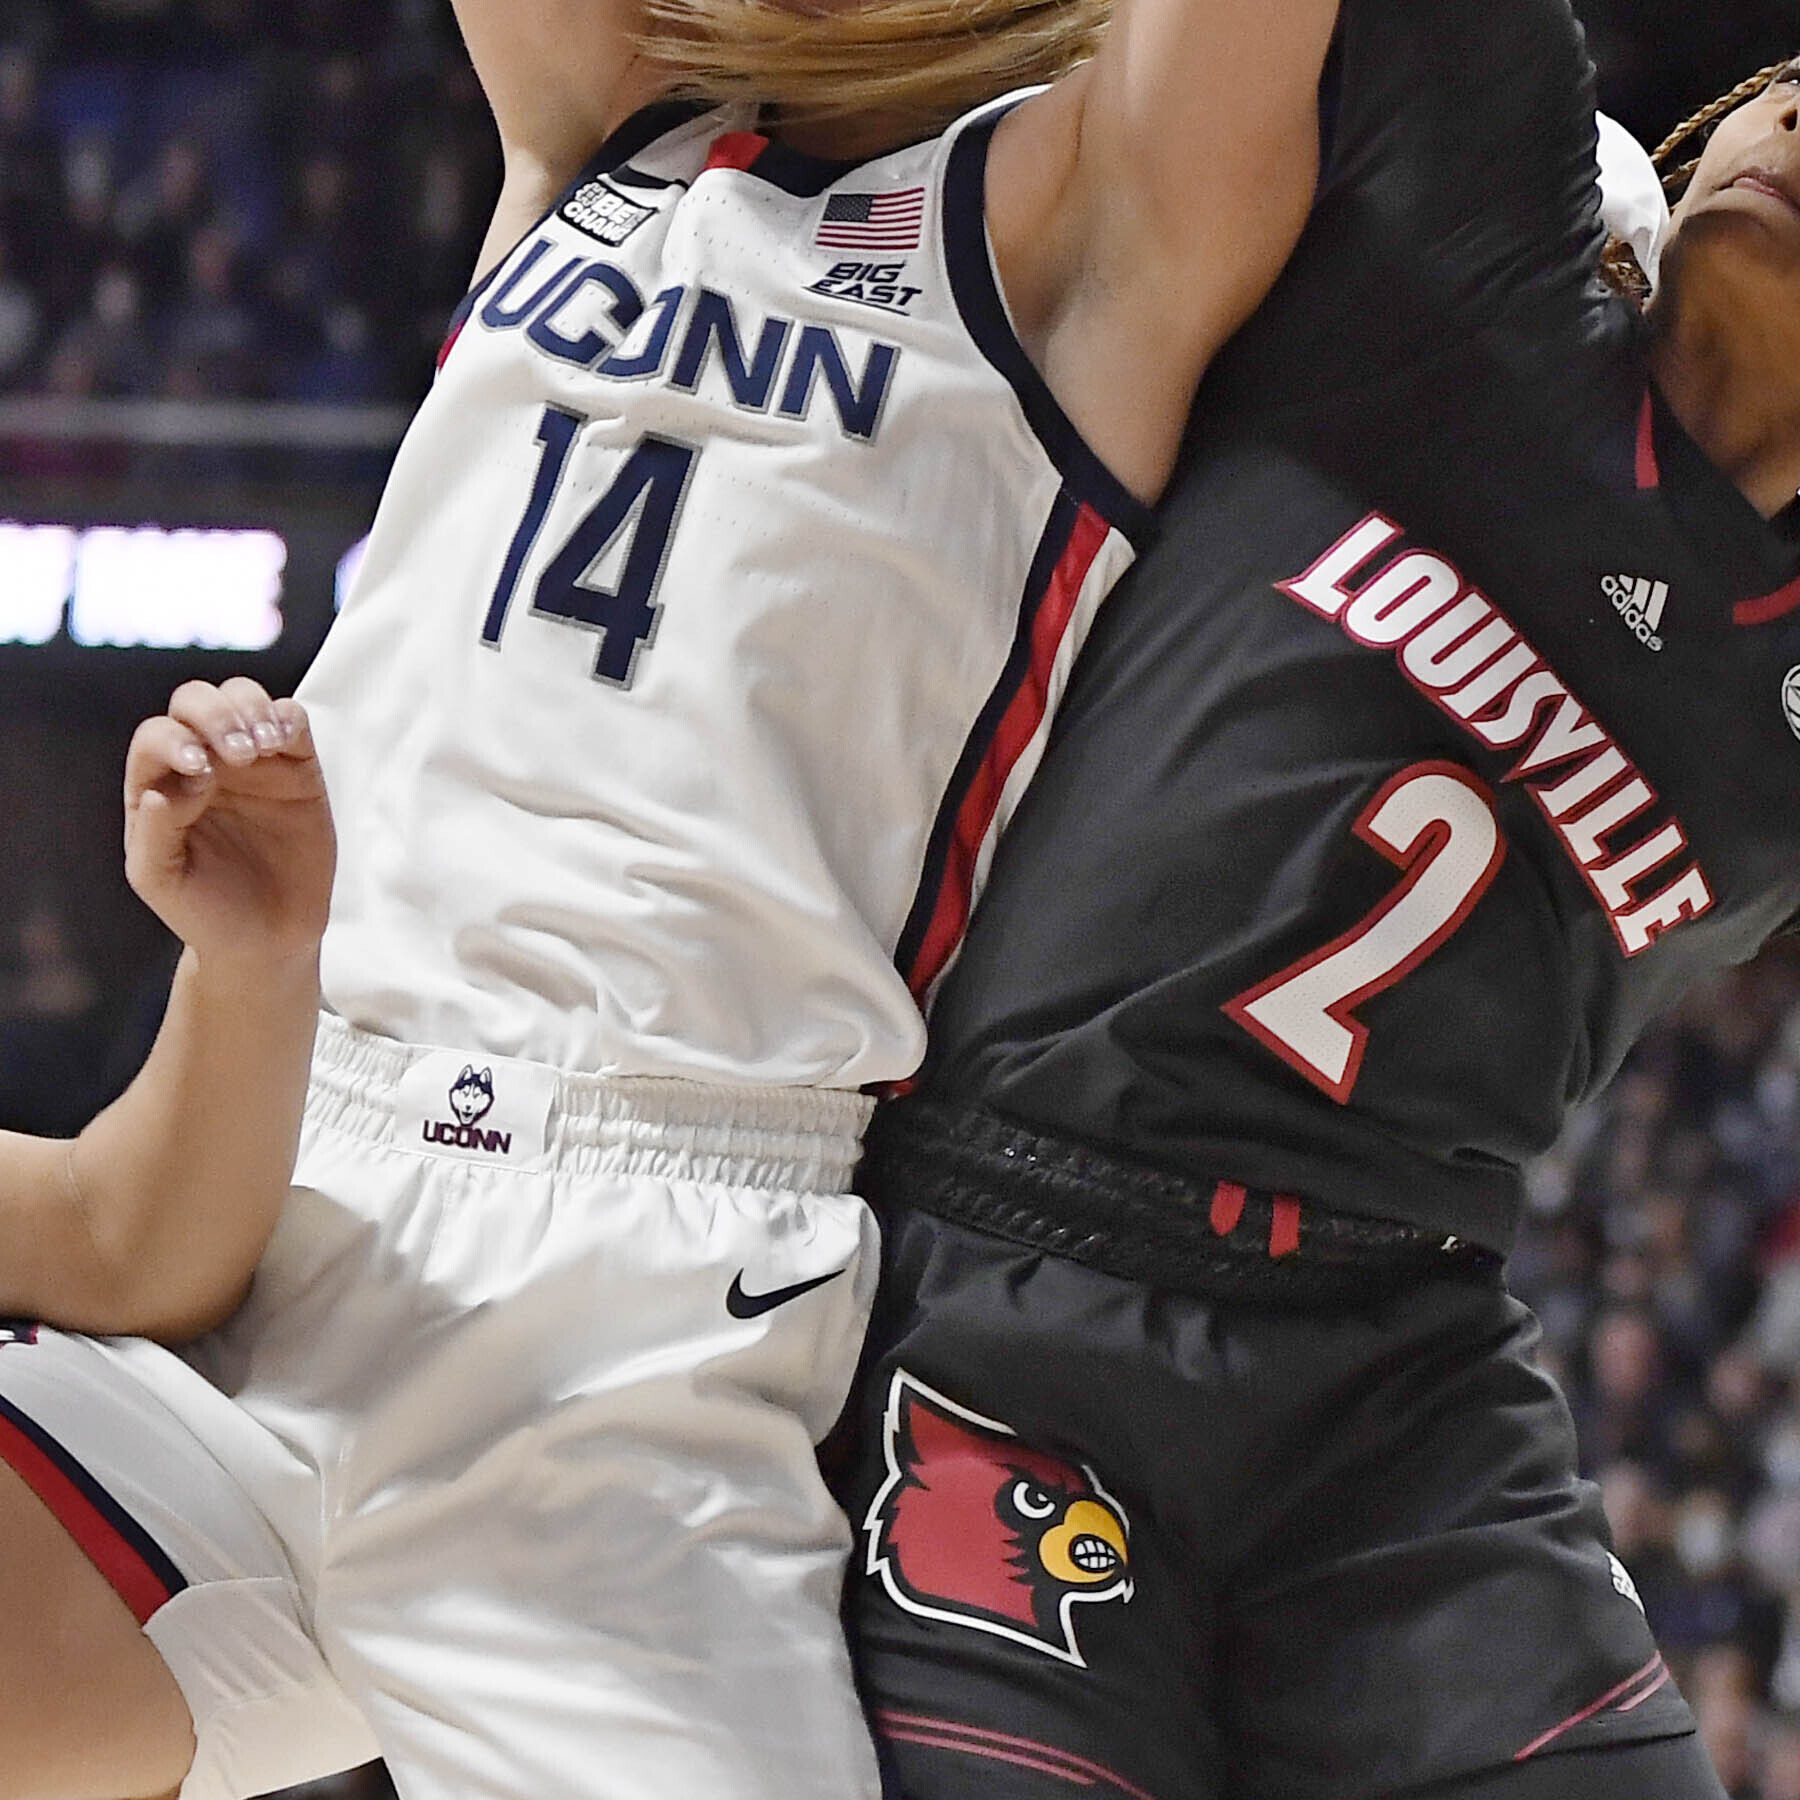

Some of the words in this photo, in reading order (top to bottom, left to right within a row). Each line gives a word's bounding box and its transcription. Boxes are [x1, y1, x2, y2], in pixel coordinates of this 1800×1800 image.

[479, 236, 901, 445] UCONN
[809, 279, 923, 306] EAST
[825, 261, 906, 283] BIG
[478, 402, 702, 691] 14
[1601, 575, 1664, 651] adidas
[1273, 510, 1715, 959] LOUISVILLE
[1220, 759, 1507, 1105] 2
[421, 1119, 512, 1154] UCONN
